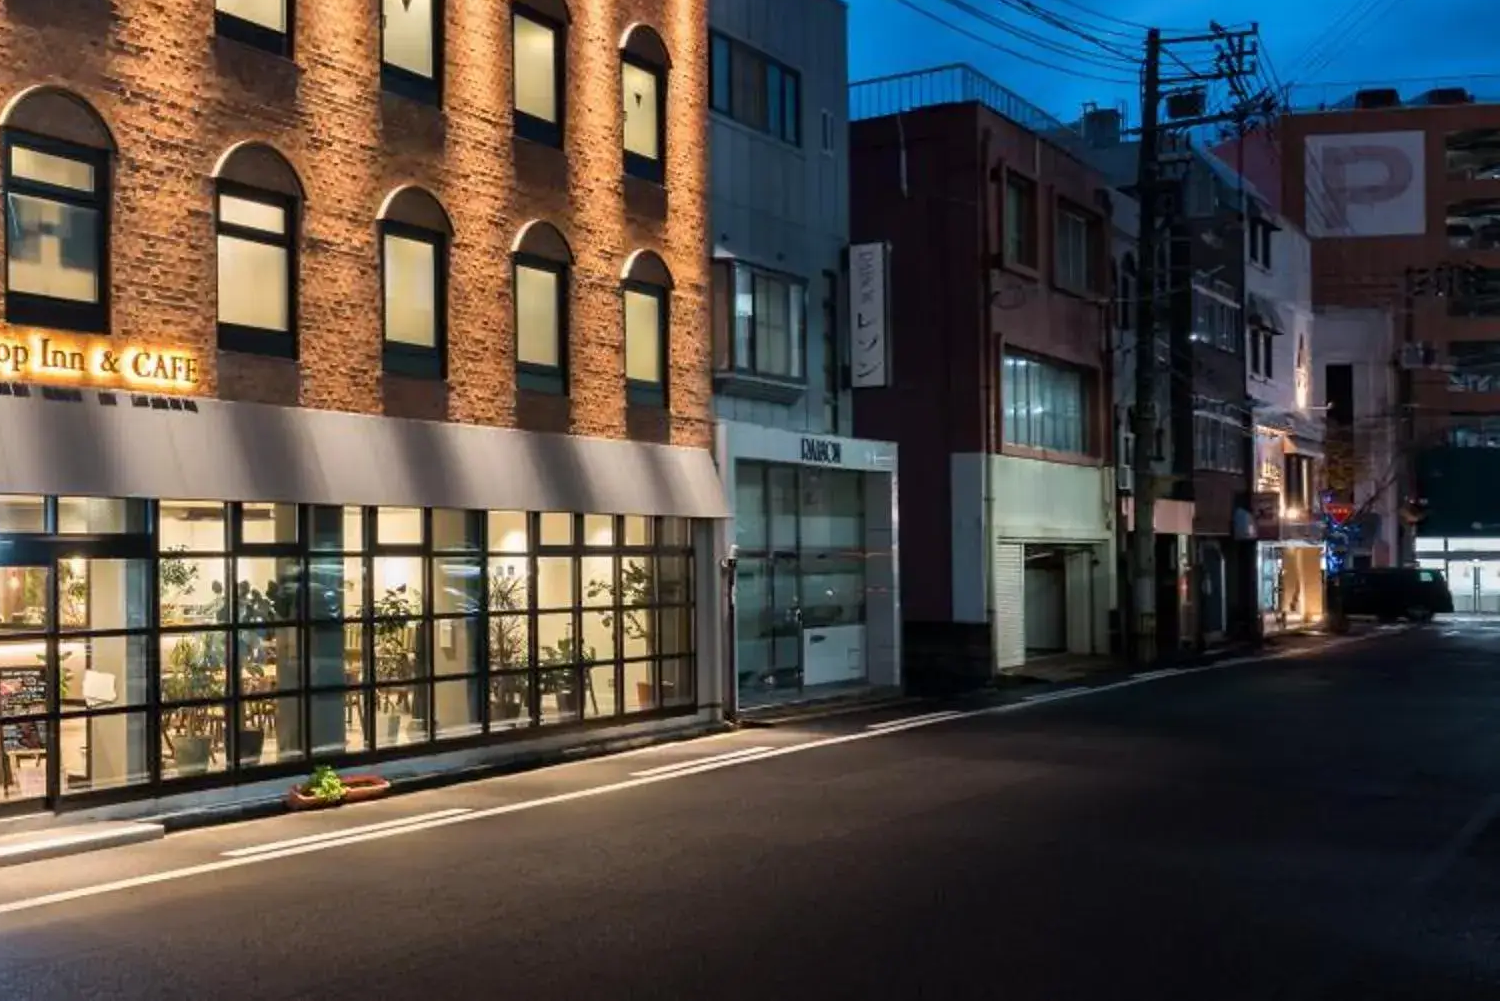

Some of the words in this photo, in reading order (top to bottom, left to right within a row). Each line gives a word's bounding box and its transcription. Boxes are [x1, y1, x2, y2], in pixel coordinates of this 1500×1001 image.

[1321, 145, 1414, 230] P
[40, 337, 85, 371] Inn
[100, 350, 120, 373] &
[132, 352, 199, 384] CAFE
